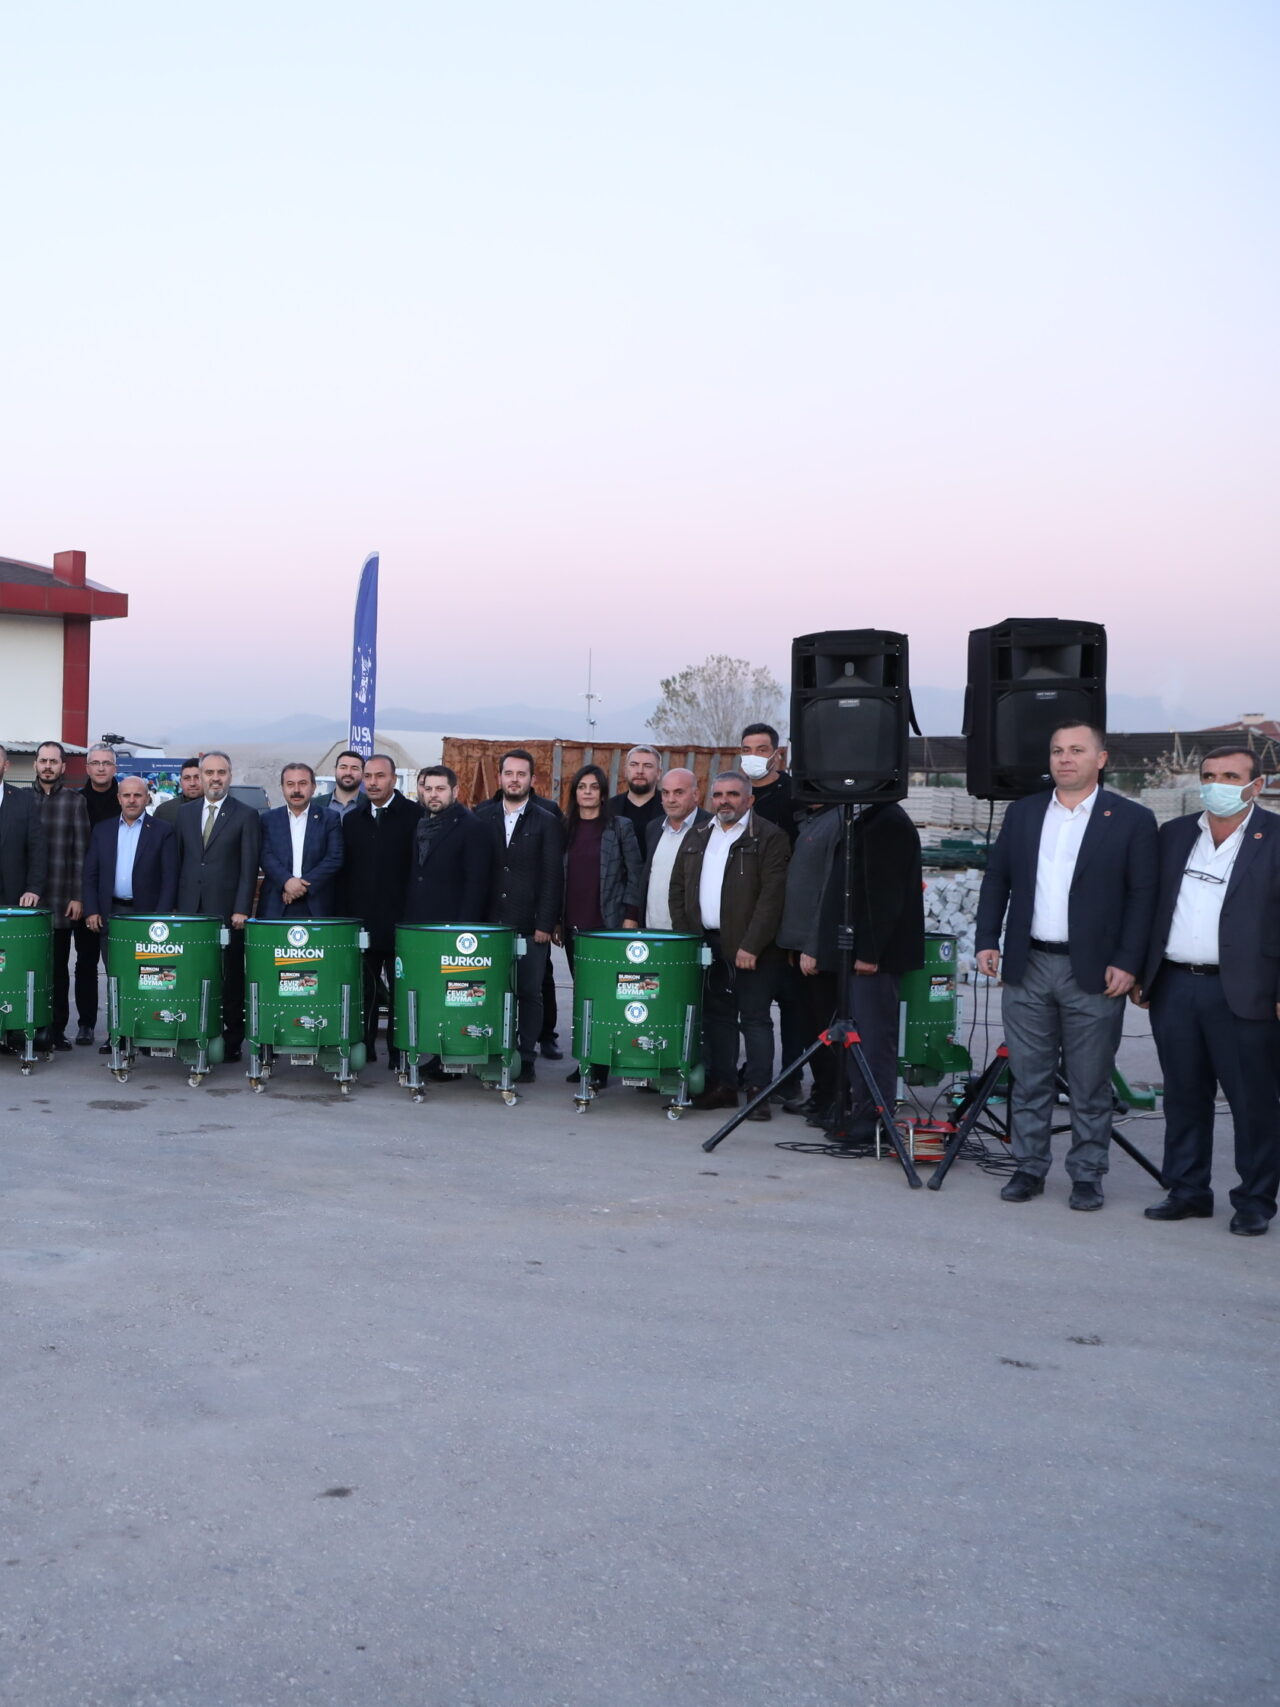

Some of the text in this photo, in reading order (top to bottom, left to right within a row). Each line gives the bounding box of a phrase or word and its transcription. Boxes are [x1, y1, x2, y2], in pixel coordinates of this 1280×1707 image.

[135, 943, 184, 954] BURKON
[274, 948, 324, 958] BURKON
[441, 955, 492, 966] BURKON
